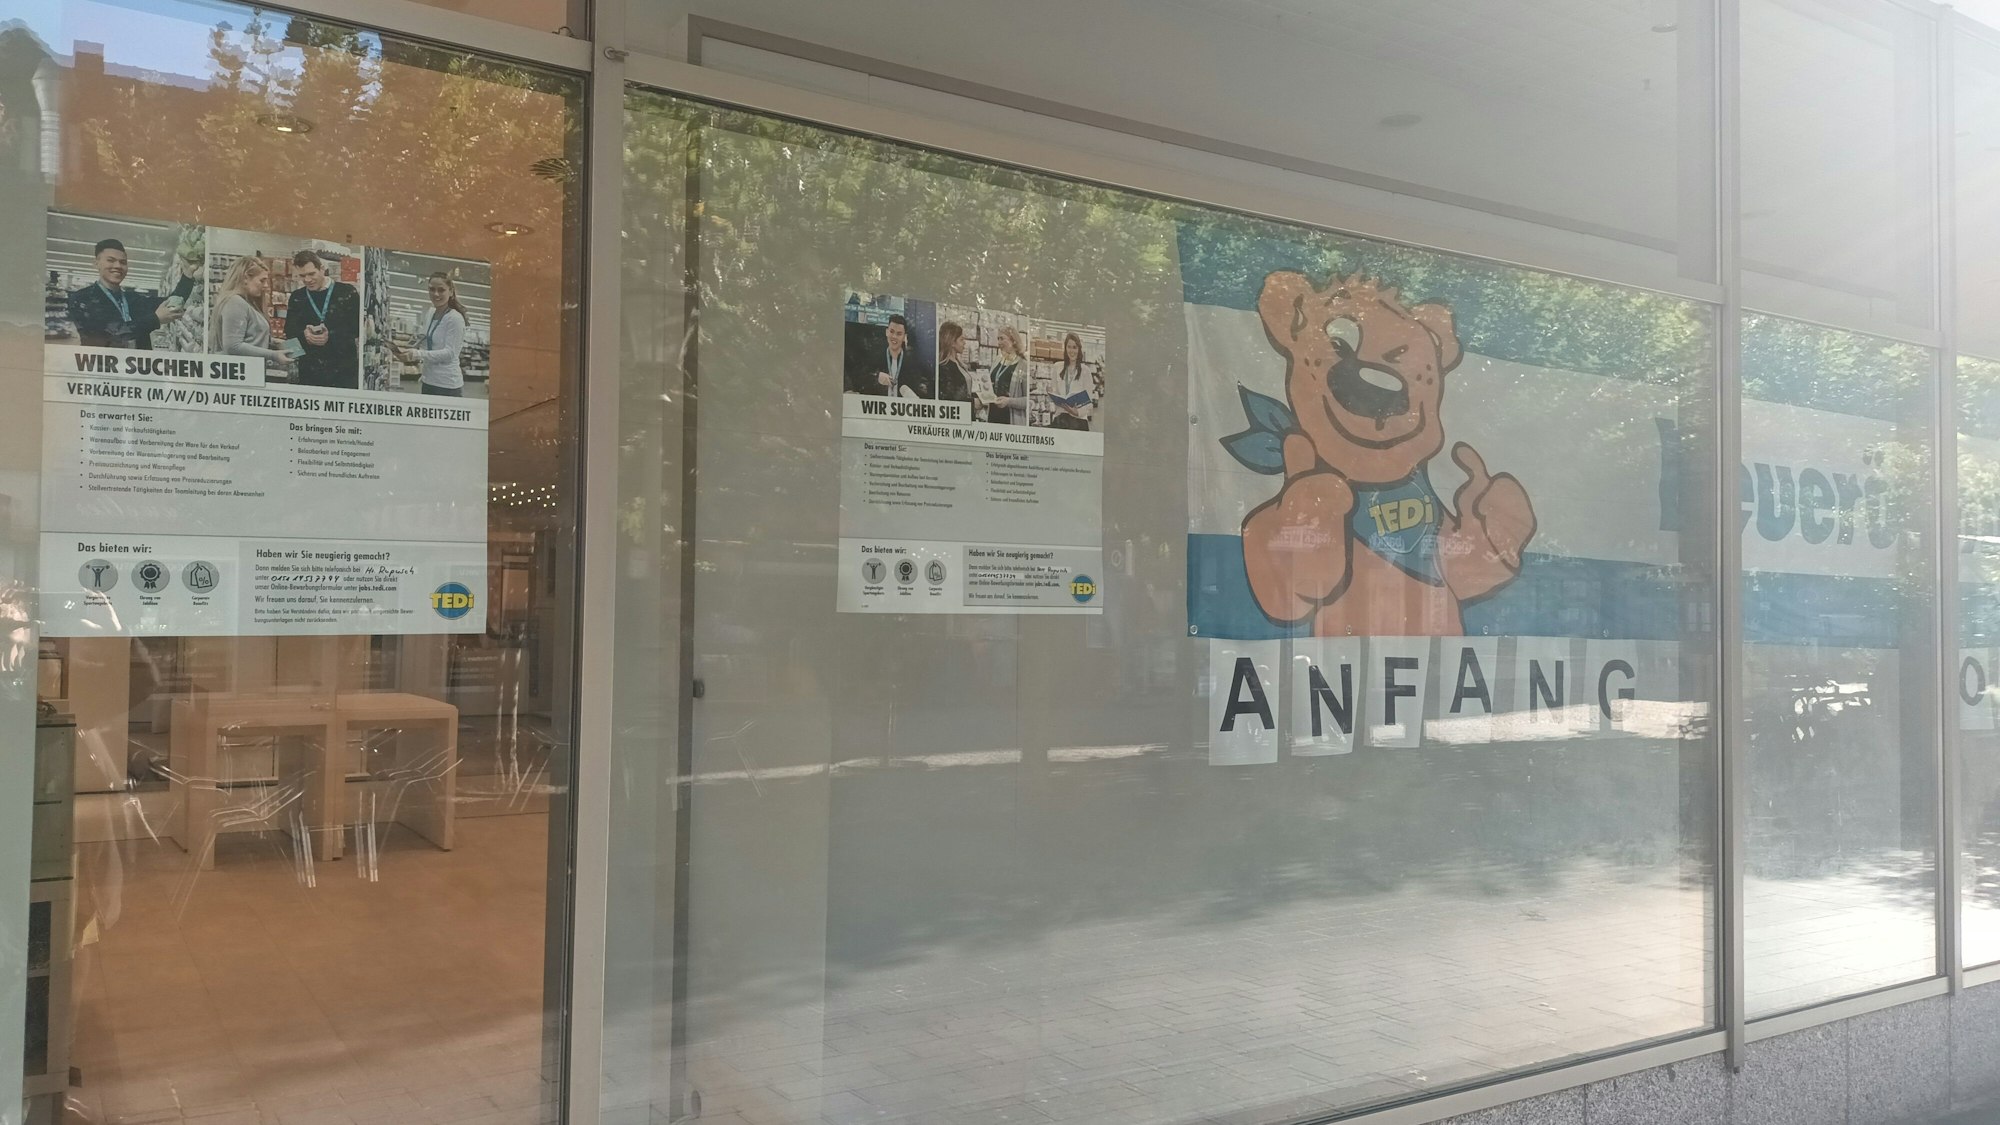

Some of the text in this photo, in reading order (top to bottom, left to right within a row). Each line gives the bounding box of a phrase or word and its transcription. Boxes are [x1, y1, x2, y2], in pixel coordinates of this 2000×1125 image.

[75, 353, 246, 381] WIR SUCHEN SIE!
[68, 382, 471, 422] VERKÄUFER (M/W/D) AUF TEILZEITBASIS MIT FLEXIBLER ARBEITSZEIT
[80, 410, 153, 422] Das erwartet Sie:
[862, 400, 960, 420] WIR SUCHEN SIE!
[290, 423, 303, 431] Das
[306, 424, 333, 435] bringen
[335, 426, 346, 434] Sie
[908, 424, 1055, 446] VERKÄUFER (M/W/D) AUF VOLLZEITBASIS
[140, 439, 174, 448] Vorbereitung
[298, 436, 328, 445] Erfahrungen
[90, 449, 124, 457] Vorbereitung
[996, 453, 1011, 461] bringen
[1370, 496, 1434, 537] TEDi
[78, 542, 152, 553] Das bieten wir:
[875, 546, 893, 554] bieten
[257, 549, 390, 562] Haben wir Sie neugierig gemacht?
[969, 549, 985, 557] Haben
[1006, 551, 1029, 560] neugierig
[1030, 552, 1054, 560] gemacht?
[1070, 582, 1096, 596] TEDi
[430, 593, 474, 609] TEDi
[1220, 647, 1636, 737] ANFANG
